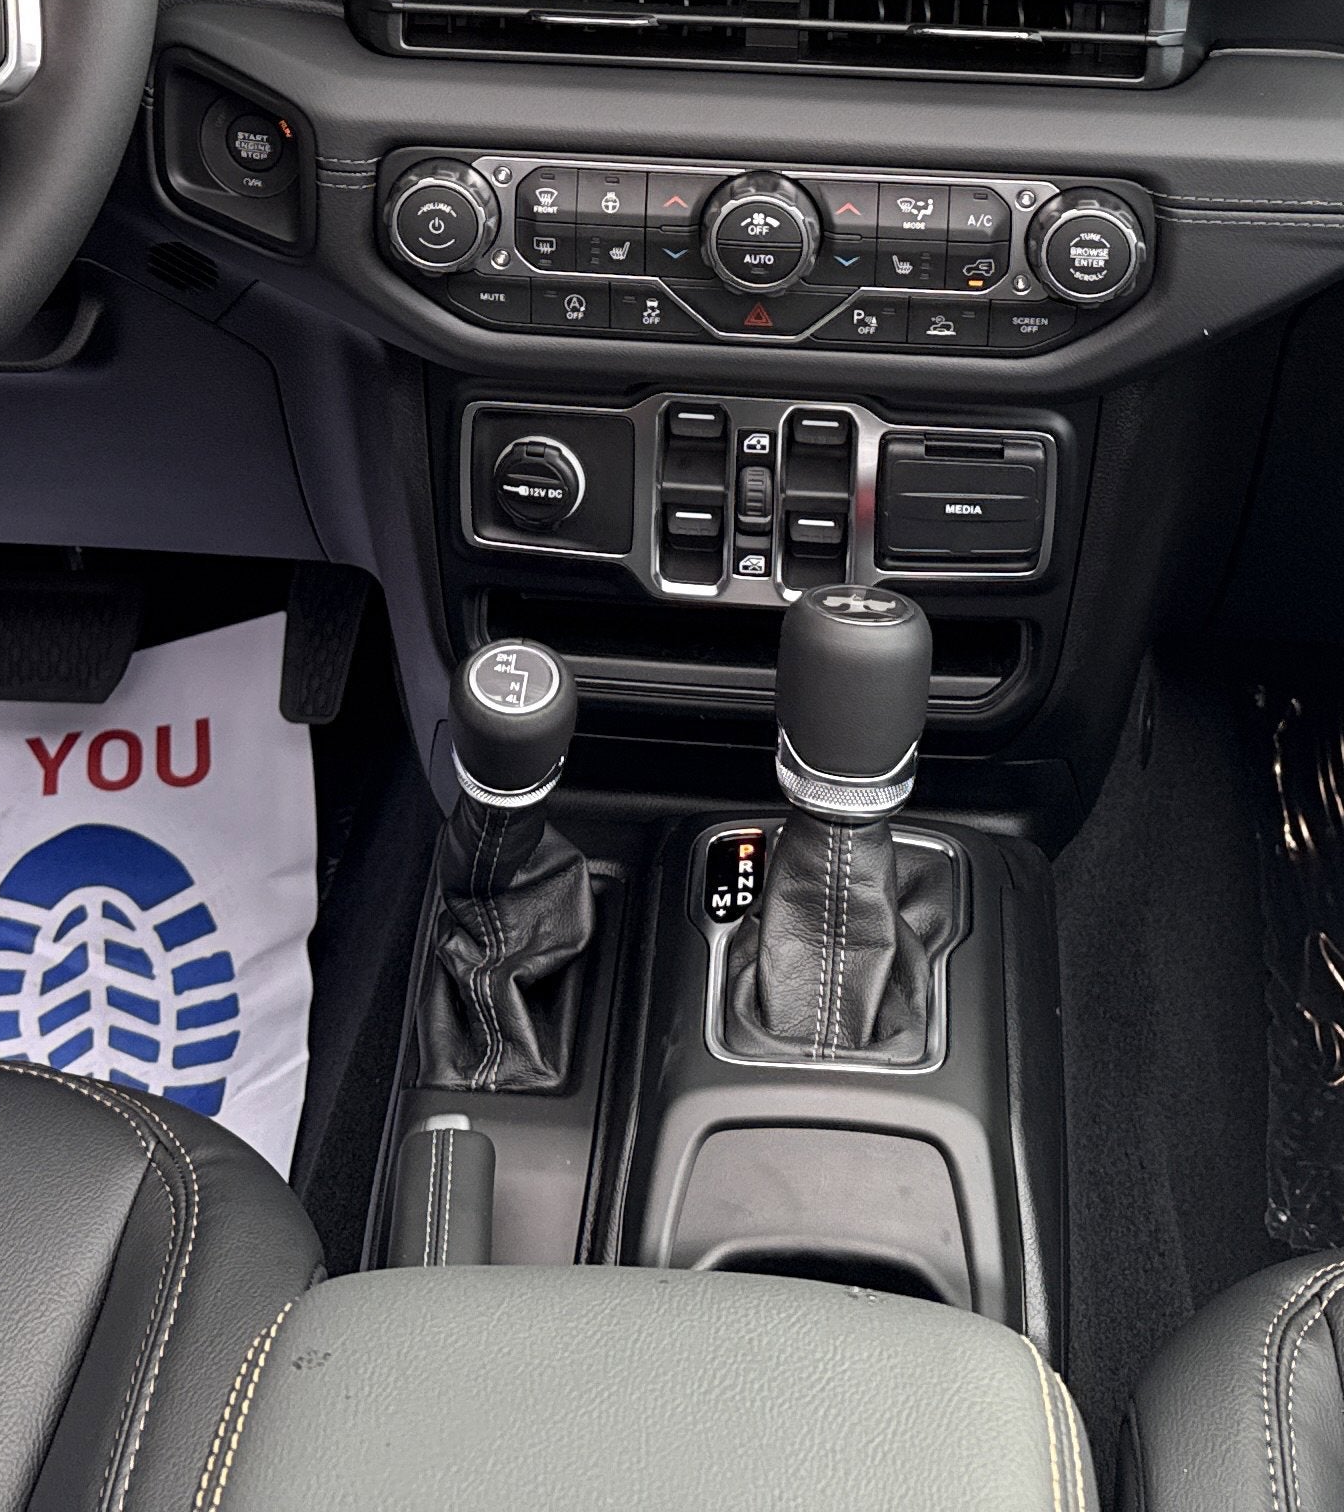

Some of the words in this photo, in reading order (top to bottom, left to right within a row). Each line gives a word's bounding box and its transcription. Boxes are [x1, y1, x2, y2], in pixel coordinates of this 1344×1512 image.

[237, 131, 269, 143] START
[235, 140, 272, 153] ENGINE
[240, 150, 269, 160] STOP
[422, 202, 453, 214] VOLUME
[533, 205, 559, 215] FRONT
[903, 221, 926, 230] MODE
[967, 213, 994, 228] A/C
[747, 224, 770, 237] OFF
[1080, 232, 1101, 242] TUNE
[1070, 247, 1109, 257] BROWSE
[743, 254, 774, 266] AUTO
[1075, 258, 1105, 268] ENTER
[1073, 272, 1105, 282] SCROLL
[480, 292, 506, 302] MUTE
[566, 311, 584, 321] OFF
[642, 315, 661, 325] OFF
[1011, 316, 1049, 328] SCREEN
[858, 325, 876, 336] OFF
[1019, 324, 1039, 334] OFF
[530, 488, 546, 498] 12V
[547, 489, 563, 499] DC
[945, 504, 983, 516] MEDIA
[494, 664, 511, 673] 4H
[510, 681, 520, 691] N
[506, 694, 519, 704] 4L
[26, 717, 212, 797] YOU
[739, 844, 754, 857] P
[739, 860, 754, 873] R
[738, 876, 754, 889] N
[711, 893, 731, 907] M
[737, 892, 753, 906] D
